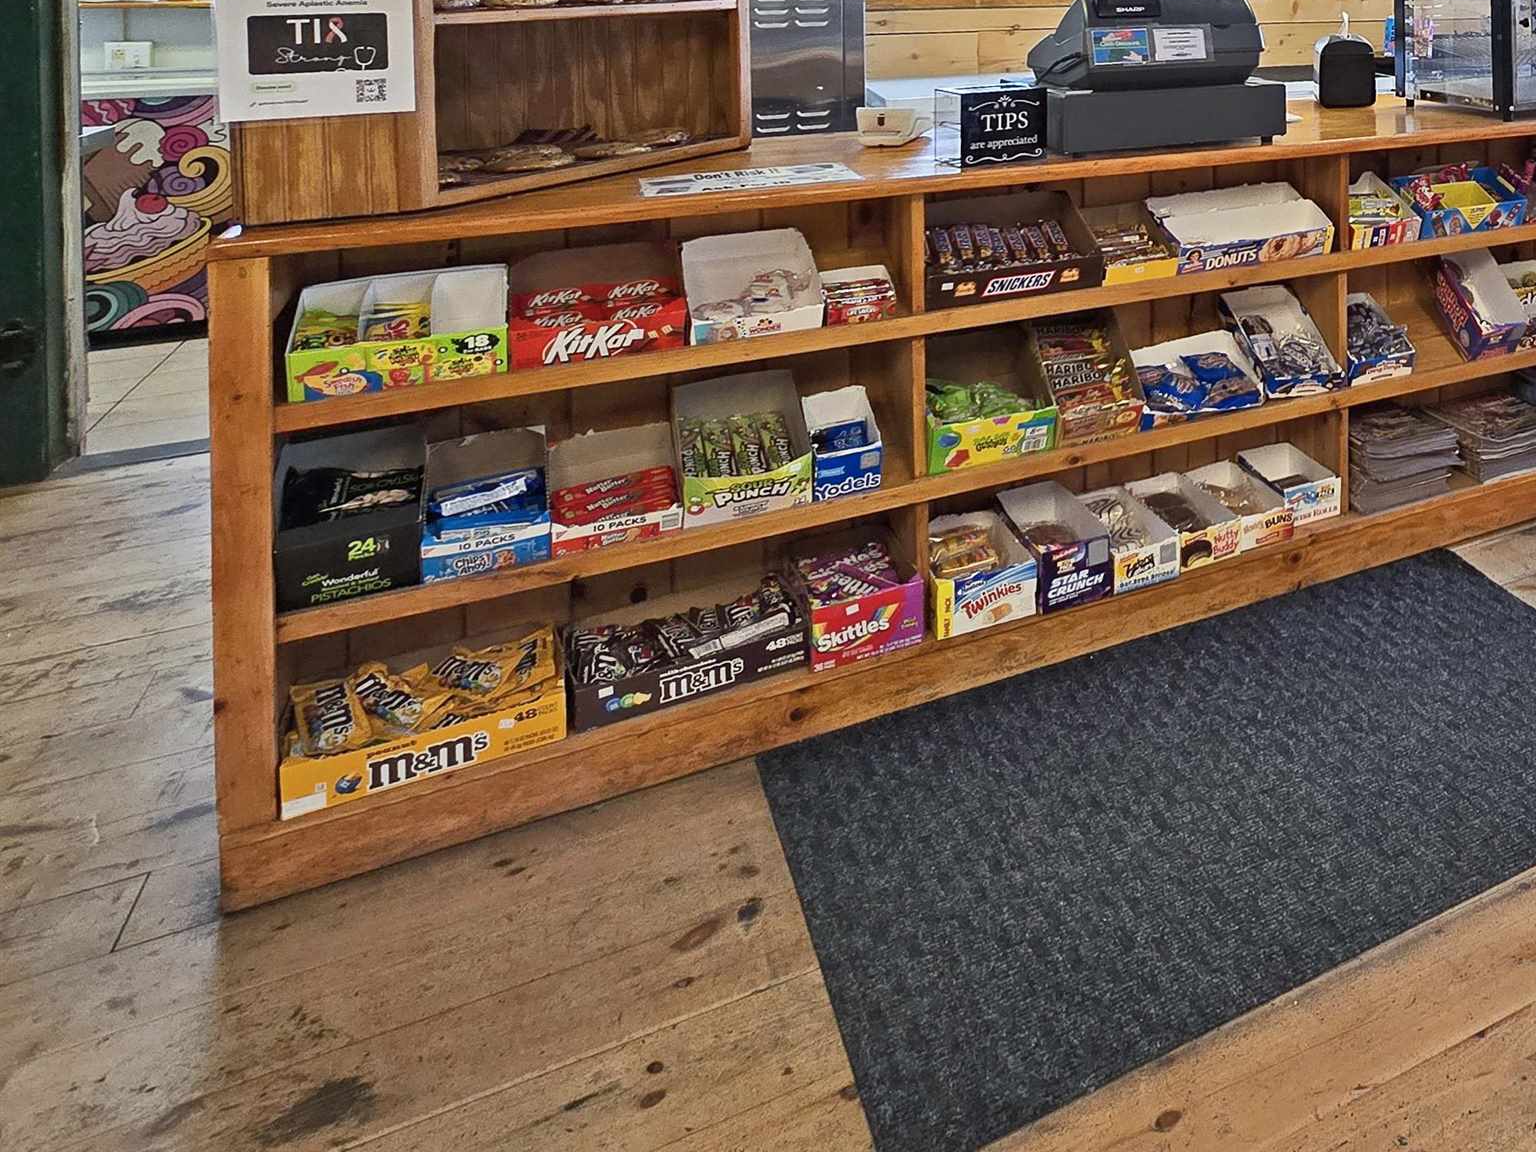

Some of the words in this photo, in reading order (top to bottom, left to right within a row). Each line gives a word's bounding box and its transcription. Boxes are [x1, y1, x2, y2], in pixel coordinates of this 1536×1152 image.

[266, 0, 297, 8] Severe
[980, 111, 1029, 133] TIPS
[987, 134, 1038, 150] appreciated
[694, 170, 732, 182] Don't
[734, 167, 765, 178] Risk
[1204, 249, 1258, 270] DONUTS
[987, 272, 1051, 295] SNICKERS
[464, 334, 490, 348] 18
[543, 323, 645, 365] KitKat
[1053, 372, 1101, 389] HARIBO
[713, 481, 791, 508] PUNCH
[816, 473, 881, 501] Yodels
[608, 516, 647, 530] PACKS
[1264, 512, 1293, 529] BUNS
[459, 543, 471, 551] 10
[475, 533, 516, 547] PACKS
[1214, 528, 1239, 543] Nutty
[347, 537, 377, 555] 24
[1213, 539, 1238, 554] Buddy
[454, 554, 486, 570] Chips
[321, 568, 380, 587] Wonderful
[1047, 573, 1105, 599] CRUNCH
[1050, 569, 1090, 589] STAR
[311, 579, 392, 604] PISTACHIOS
[961, 583, 1022, 619] Twinkies
[817, 618, 890, 652] Skittles
[765, 638, 786, 651] 48
[659, 657, 745, 703] m&m's
[514, 708, 537, 723] 48
[368, 732, 490, 791] m&m's
